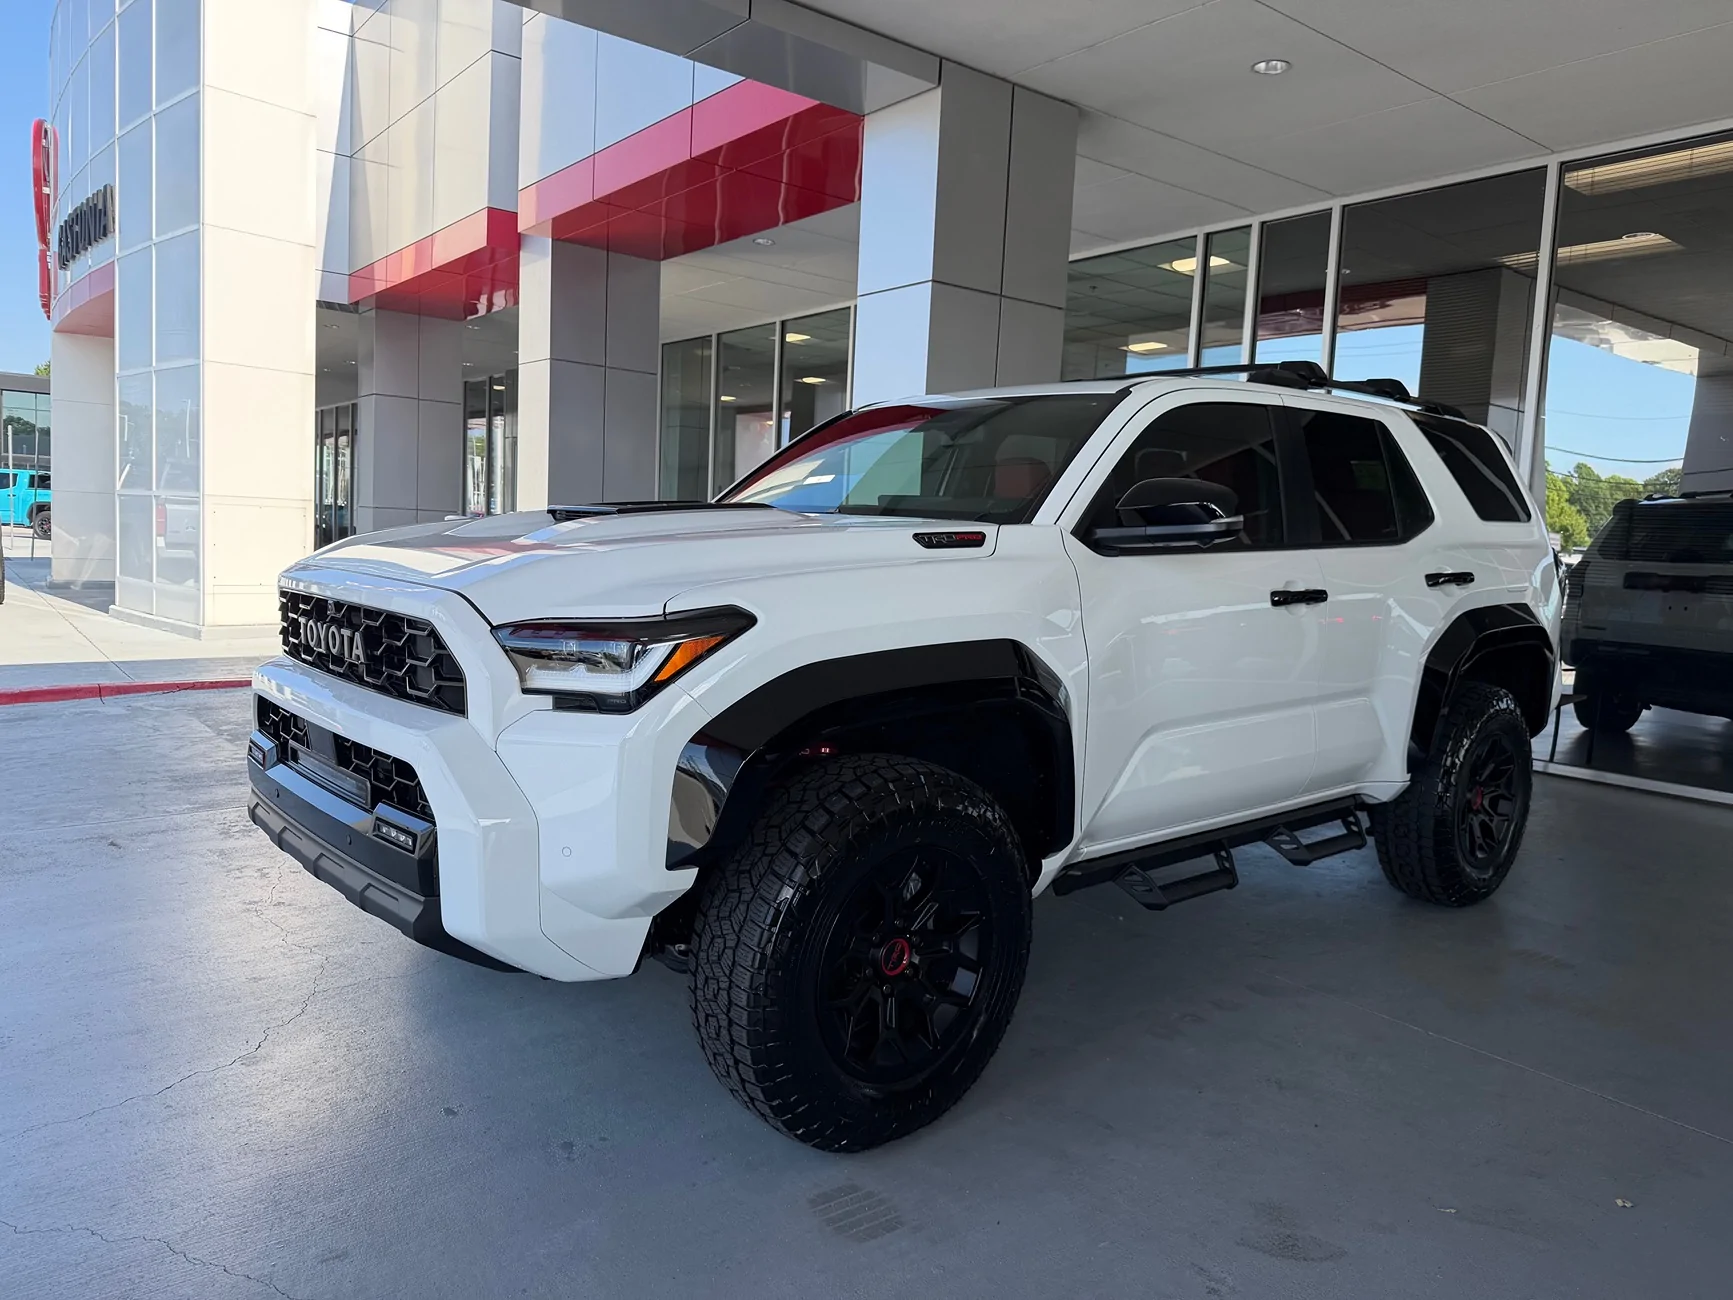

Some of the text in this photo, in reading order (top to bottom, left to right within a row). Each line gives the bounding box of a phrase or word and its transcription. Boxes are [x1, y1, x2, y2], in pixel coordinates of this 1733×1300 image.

[919, 533, 982, 544] TRD PRO
[299, 617, 365, 663] TOYOTA
